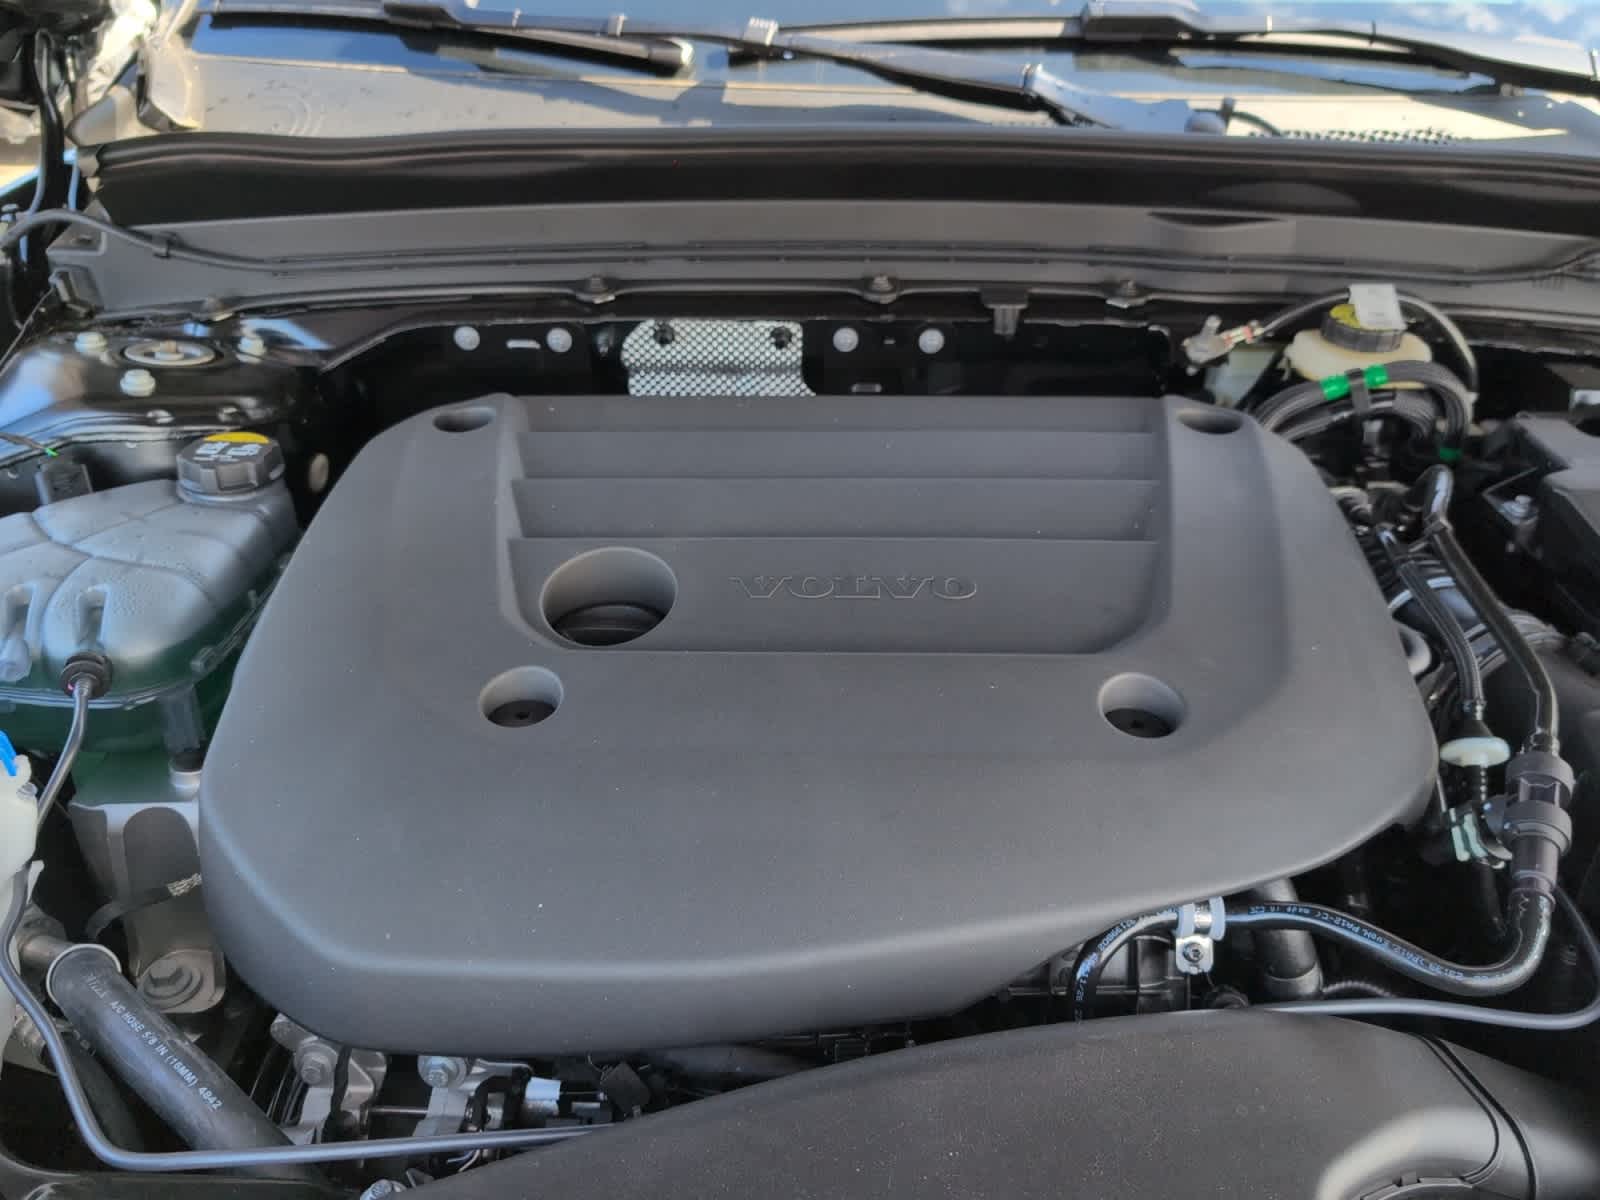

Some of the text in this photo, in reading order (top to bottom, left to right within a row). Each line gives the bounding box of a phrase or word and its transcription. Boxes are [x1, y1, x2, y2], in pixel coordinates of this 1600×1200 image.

[727, 575, 977, 599] VOLVO
[123, 1010, 145, 1032] HOSE
[155, 1043, 169, 1056] IN
[198, 1086, 222, 1109] 4842
